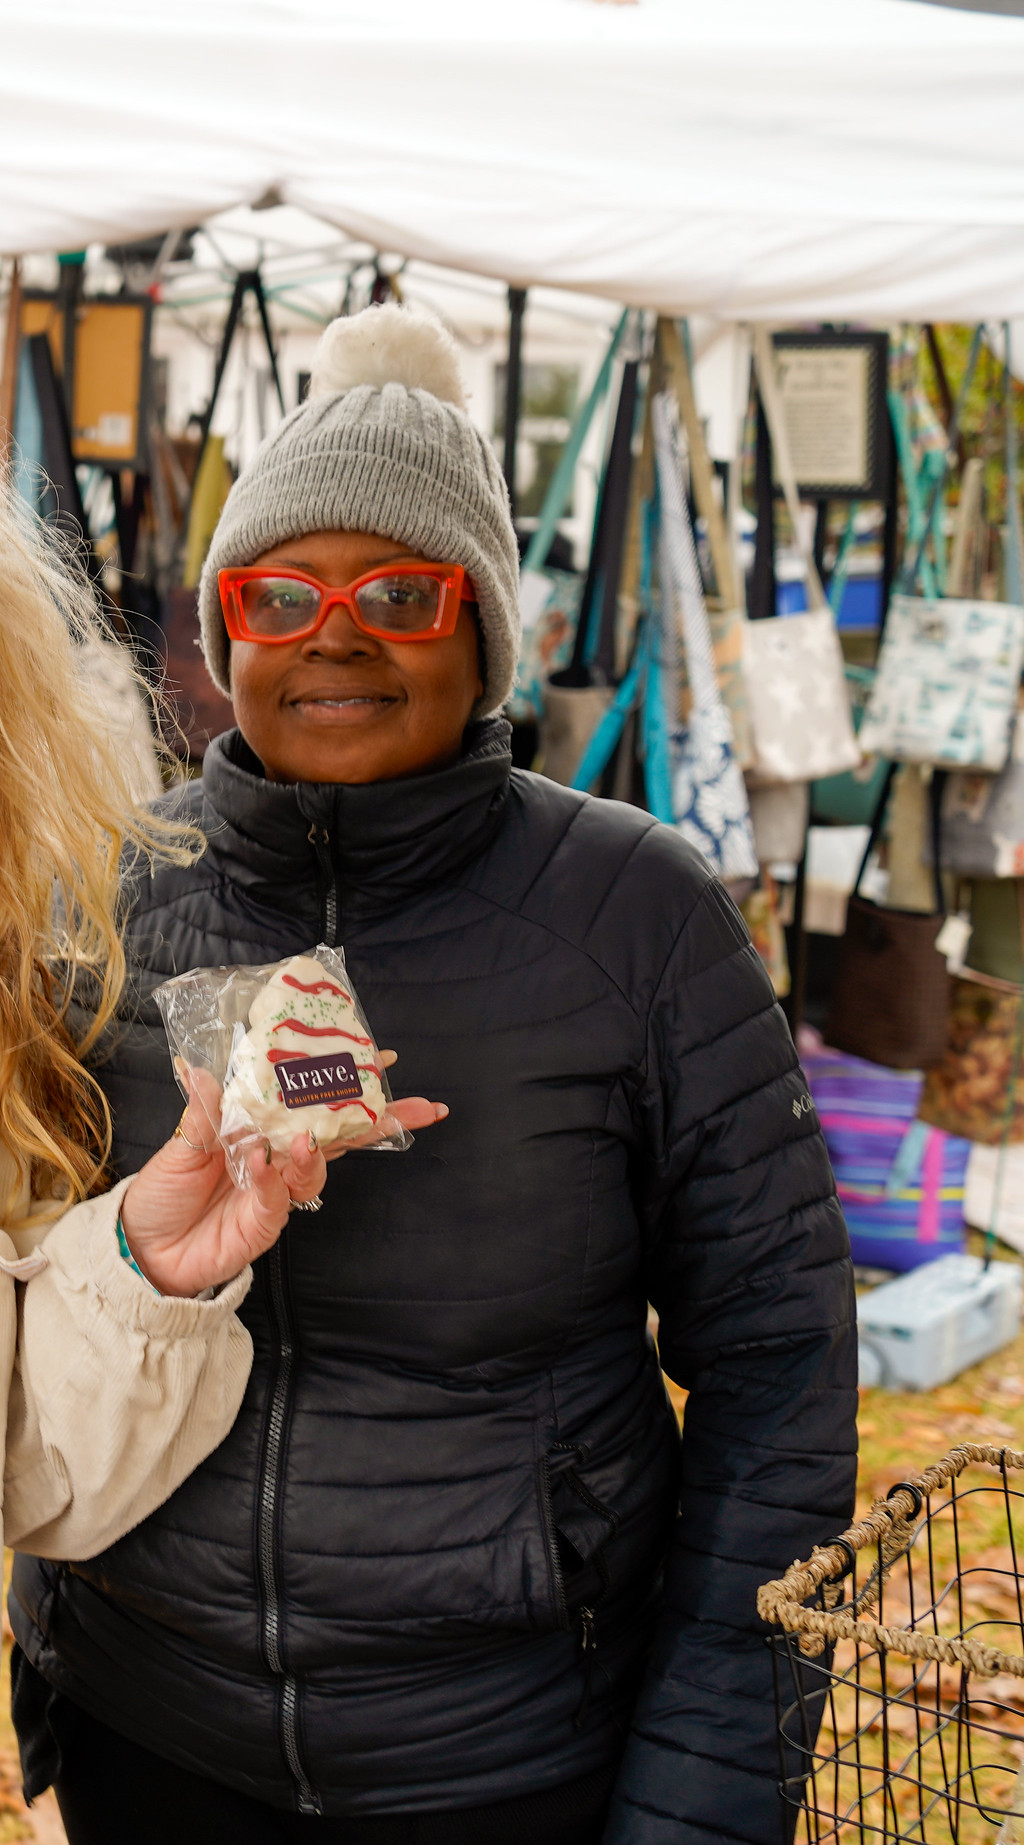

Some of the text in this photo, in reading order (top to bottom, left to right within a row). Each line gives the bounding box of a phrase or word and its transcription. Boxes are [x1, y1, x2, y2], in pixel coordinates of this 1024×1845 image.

[278, 1065, 355, 1092] krave.
[294, 1094, 319, 1104] GLUTEN
[320, 1090, 335, 1099] FREE
[336, 1087, 359, 1096] SHOPPE
